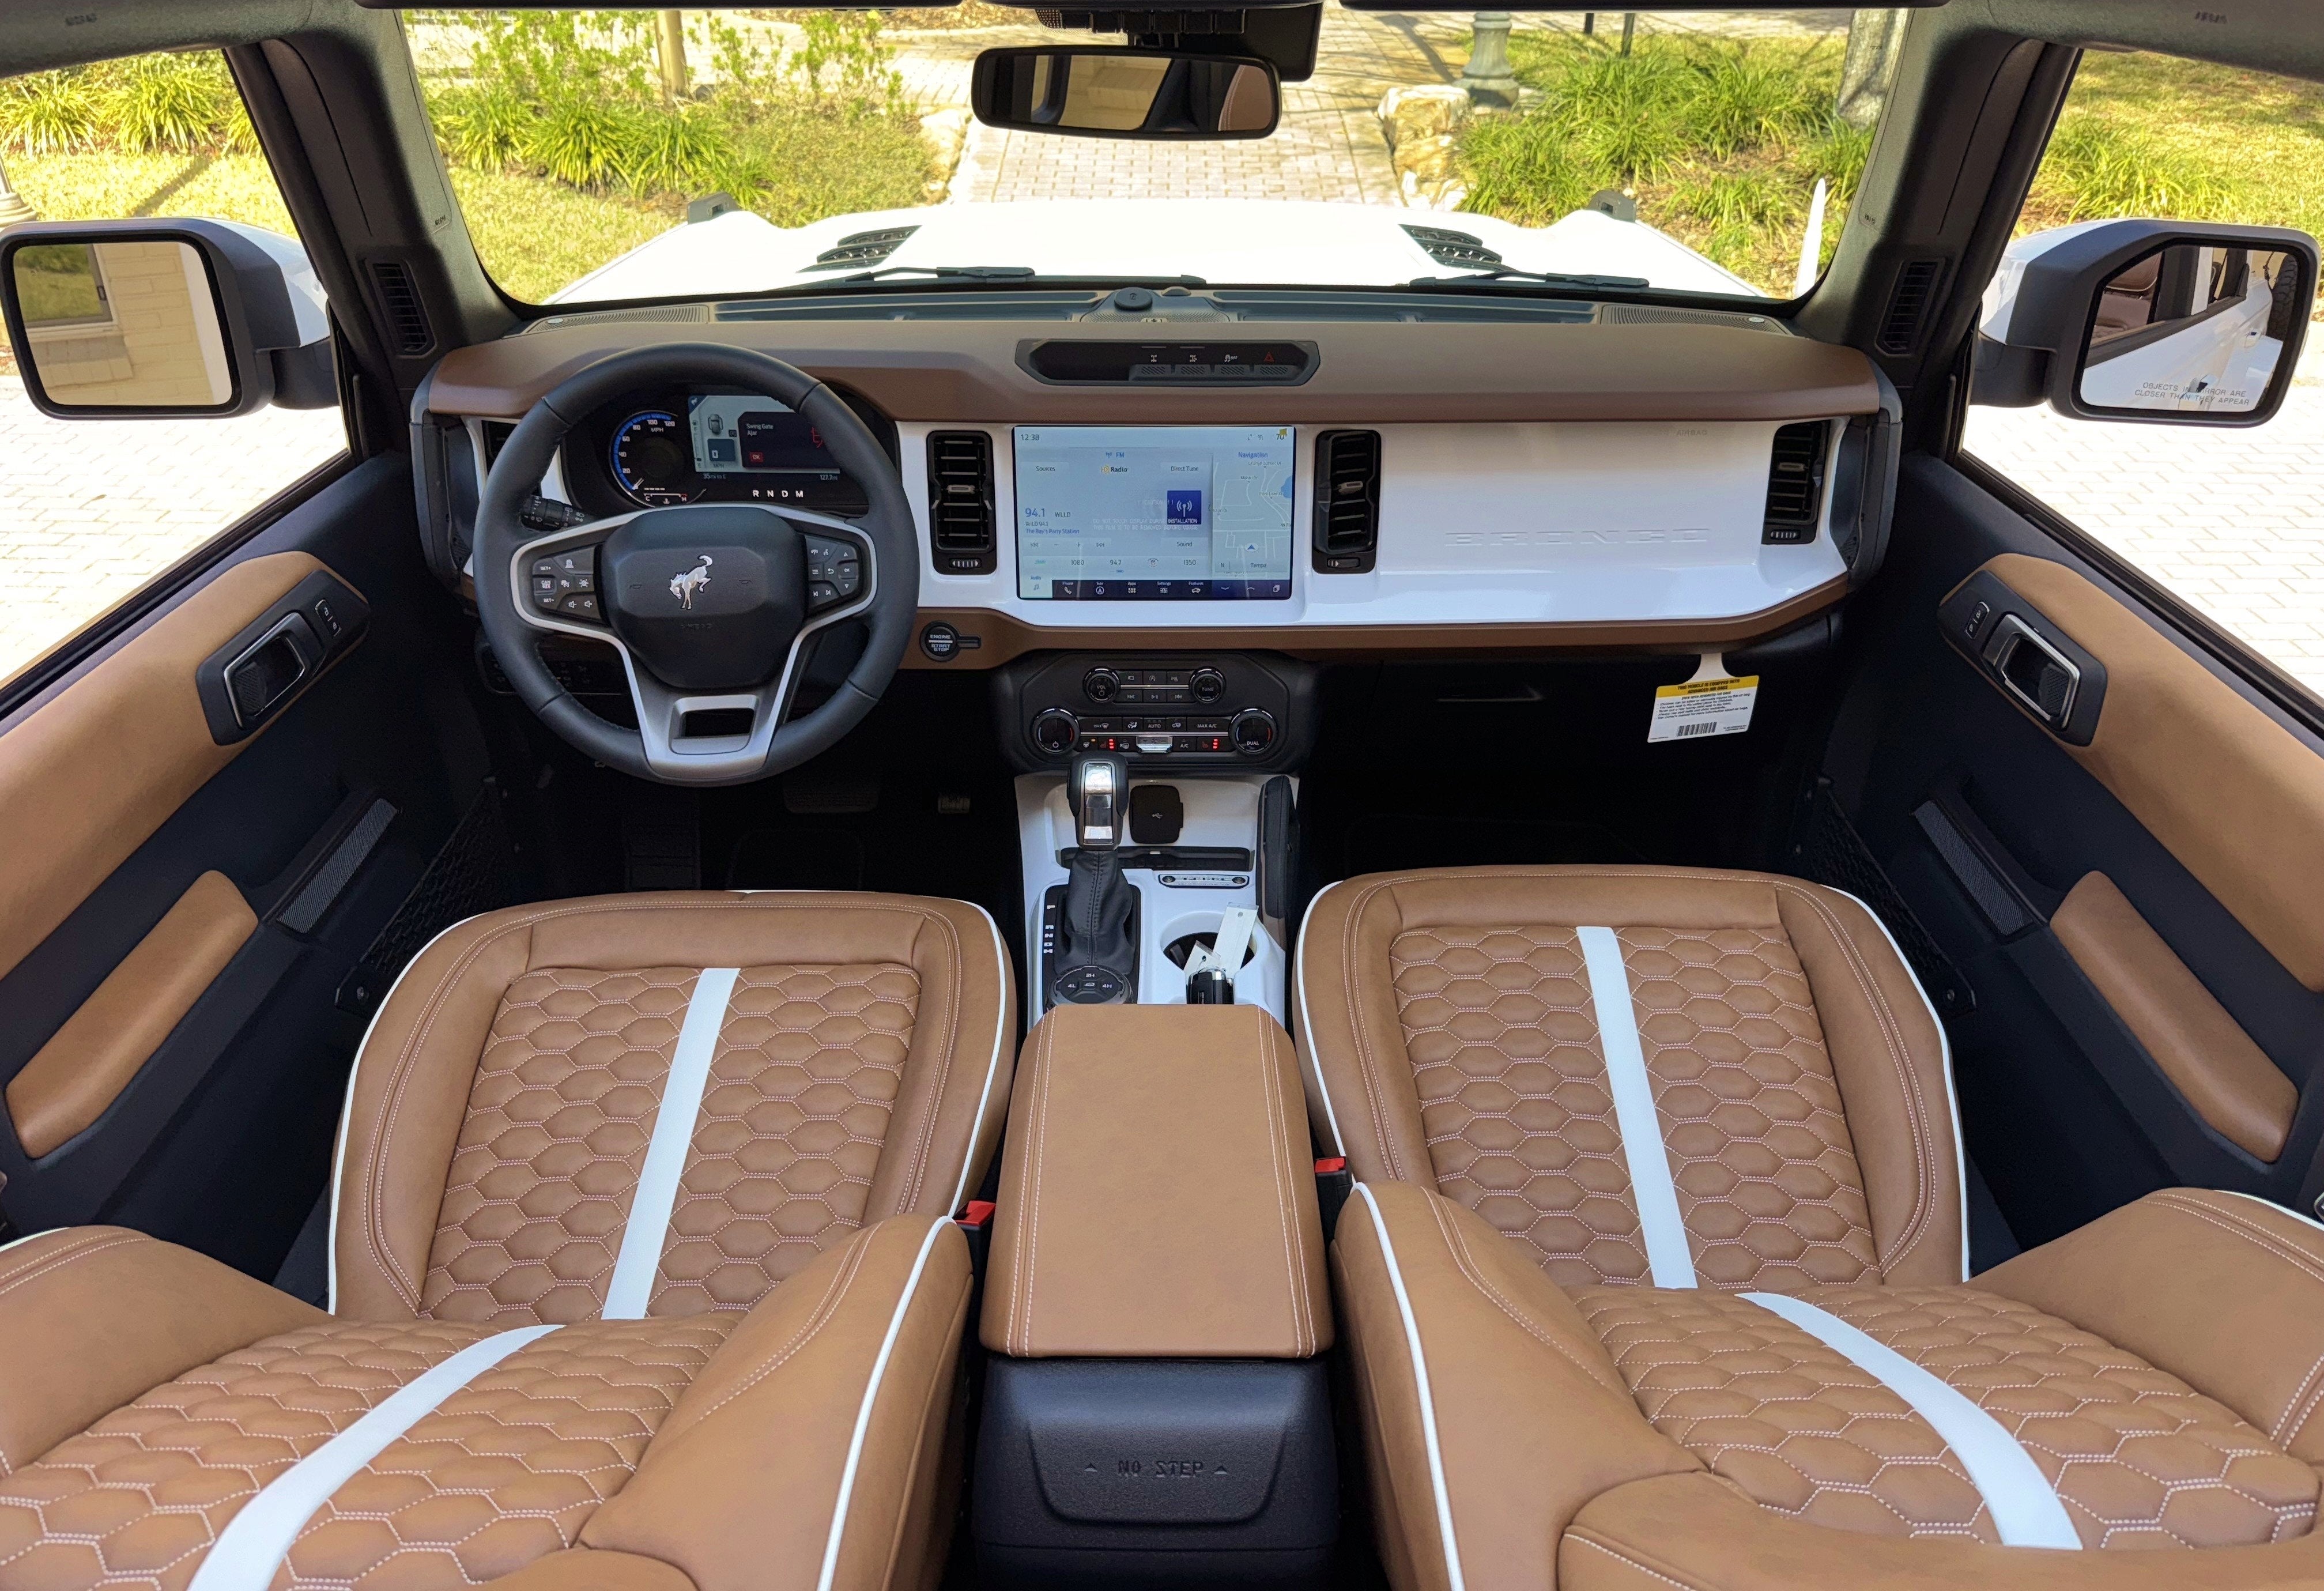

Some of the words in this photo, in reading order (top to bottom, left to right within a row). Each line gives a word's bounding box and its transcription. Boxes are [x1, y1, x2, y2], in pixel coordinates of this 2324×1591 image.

[2142, 382, 2179, 392] OBJECTS
[2134, 390, 2165, 398] CLOSER
[2218, 397, 2250, 405] APPEAR
[752, 489, 760, 497] R
[1025, 508, 1046, 518] 94.1
[1117, 1460, 1142, 1477] NO
[1155, 1460, 1204, 1478] STEP
